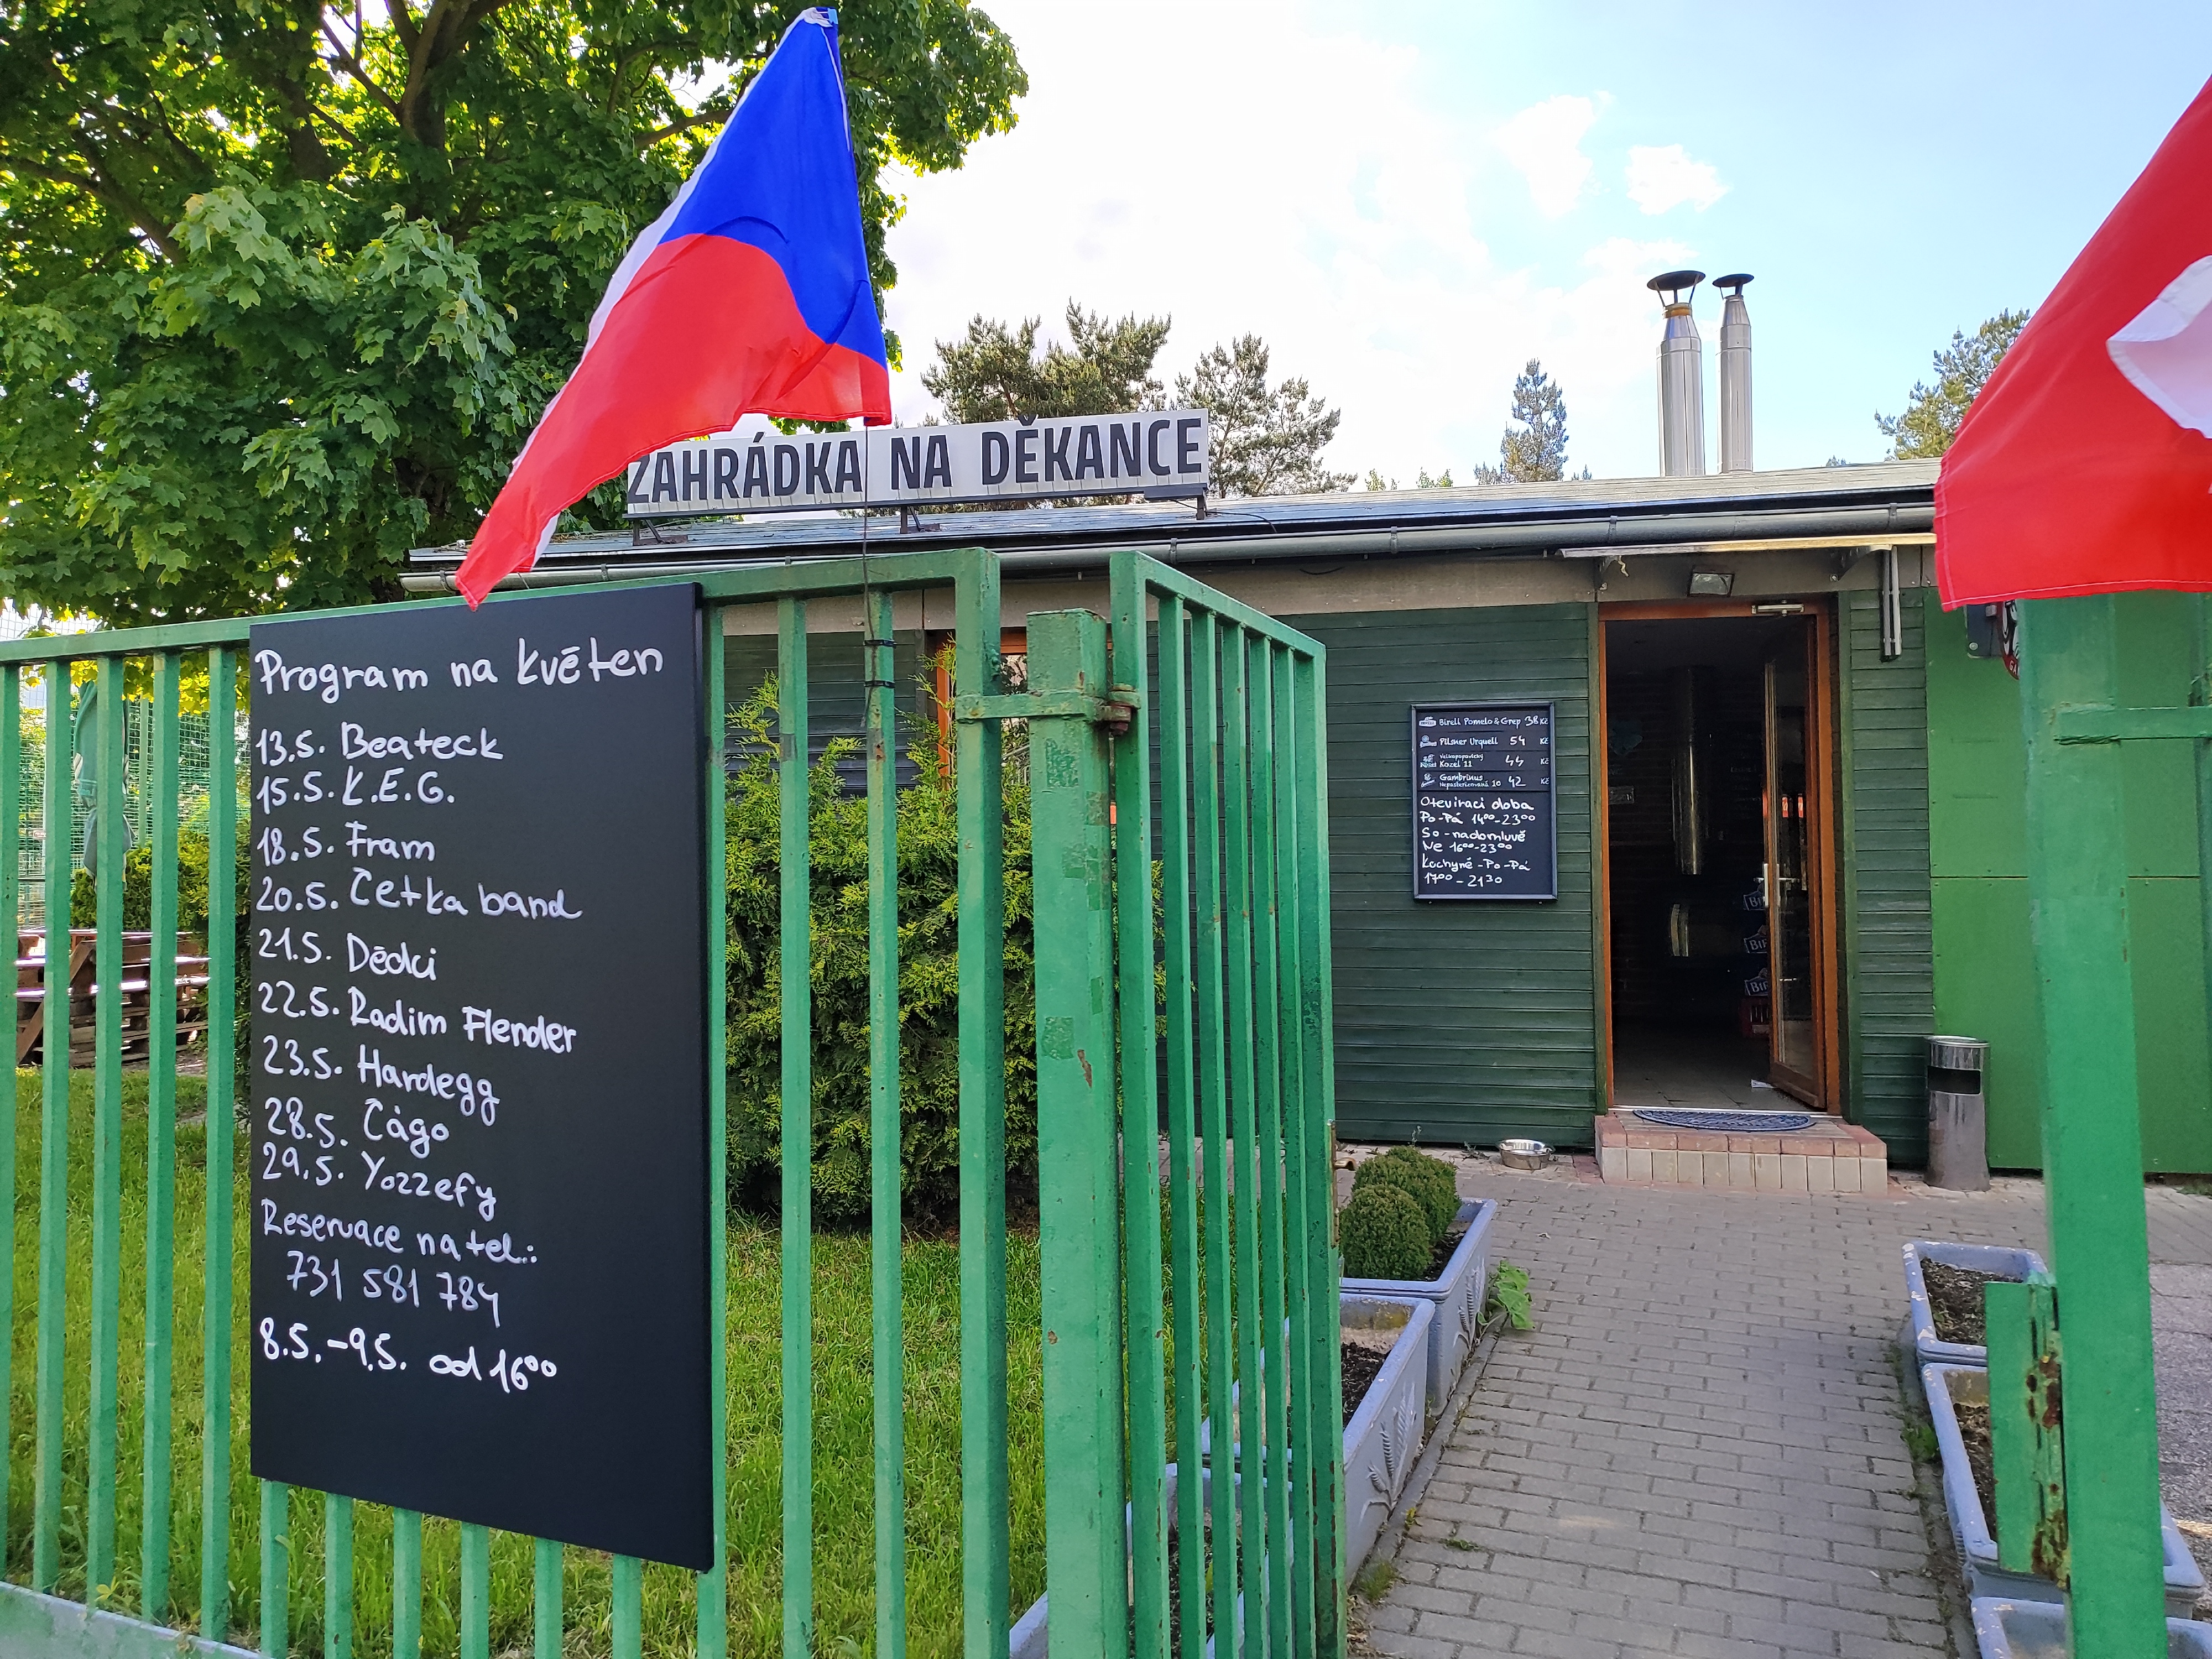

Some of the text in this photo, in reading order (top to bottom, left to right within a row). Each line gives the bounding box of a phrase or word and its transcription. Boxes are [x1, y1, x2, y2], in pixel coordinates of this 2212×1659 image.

[627, 414, 1202, 504] ZAHRÁDKA NA DĚKANCE
[254, 649, 429, 704] Program
[450, 659, 498, 687] na
[341, 721, 504, 760] Beateck
[1439, 737, 1467, 746] Pilsner
[1469, 736, 1499, 749] Urquell
[1510, 735, 1526, 746] 54
[1463, 717, 1493, 726] Pomelo
[1500, 717, 1521, 729] Grep
[1439, 760, 1461, 768] Kozel
[1439, 772, 1483, 781] Gambrinus
[1508, 775, 1527, 788] 42
[1491, 779, 1501, 787] 10
[342, 765, 455, 806] K.E.G.
[1491, 797, 1535, 811] doba
[257, 820, 435, 867] 18.5. Fram
[1421, 827, 1439, 838] So
[1422, 840, 1443, 852] Ne
[255, 876, 338, 912] 20.5.
[478, 883, 583, 920] band
[258, 927, 331, 964] 21.5.
[258, 980, 577, 1053] 22.5. Radim Flender
[263, 1035, 500, 1126] 23.5. Hardegg
[264, 1097, 348, 1149] 28.5.
[361, 1150, 497, 1222] Yozzefy
[261, 1198, 404, 1253] Reservace
[416, 1233, 461, 1261] na
[286, 1250, 500, 1328] 731 581 784
[429, 1346, 482, 1381] od
